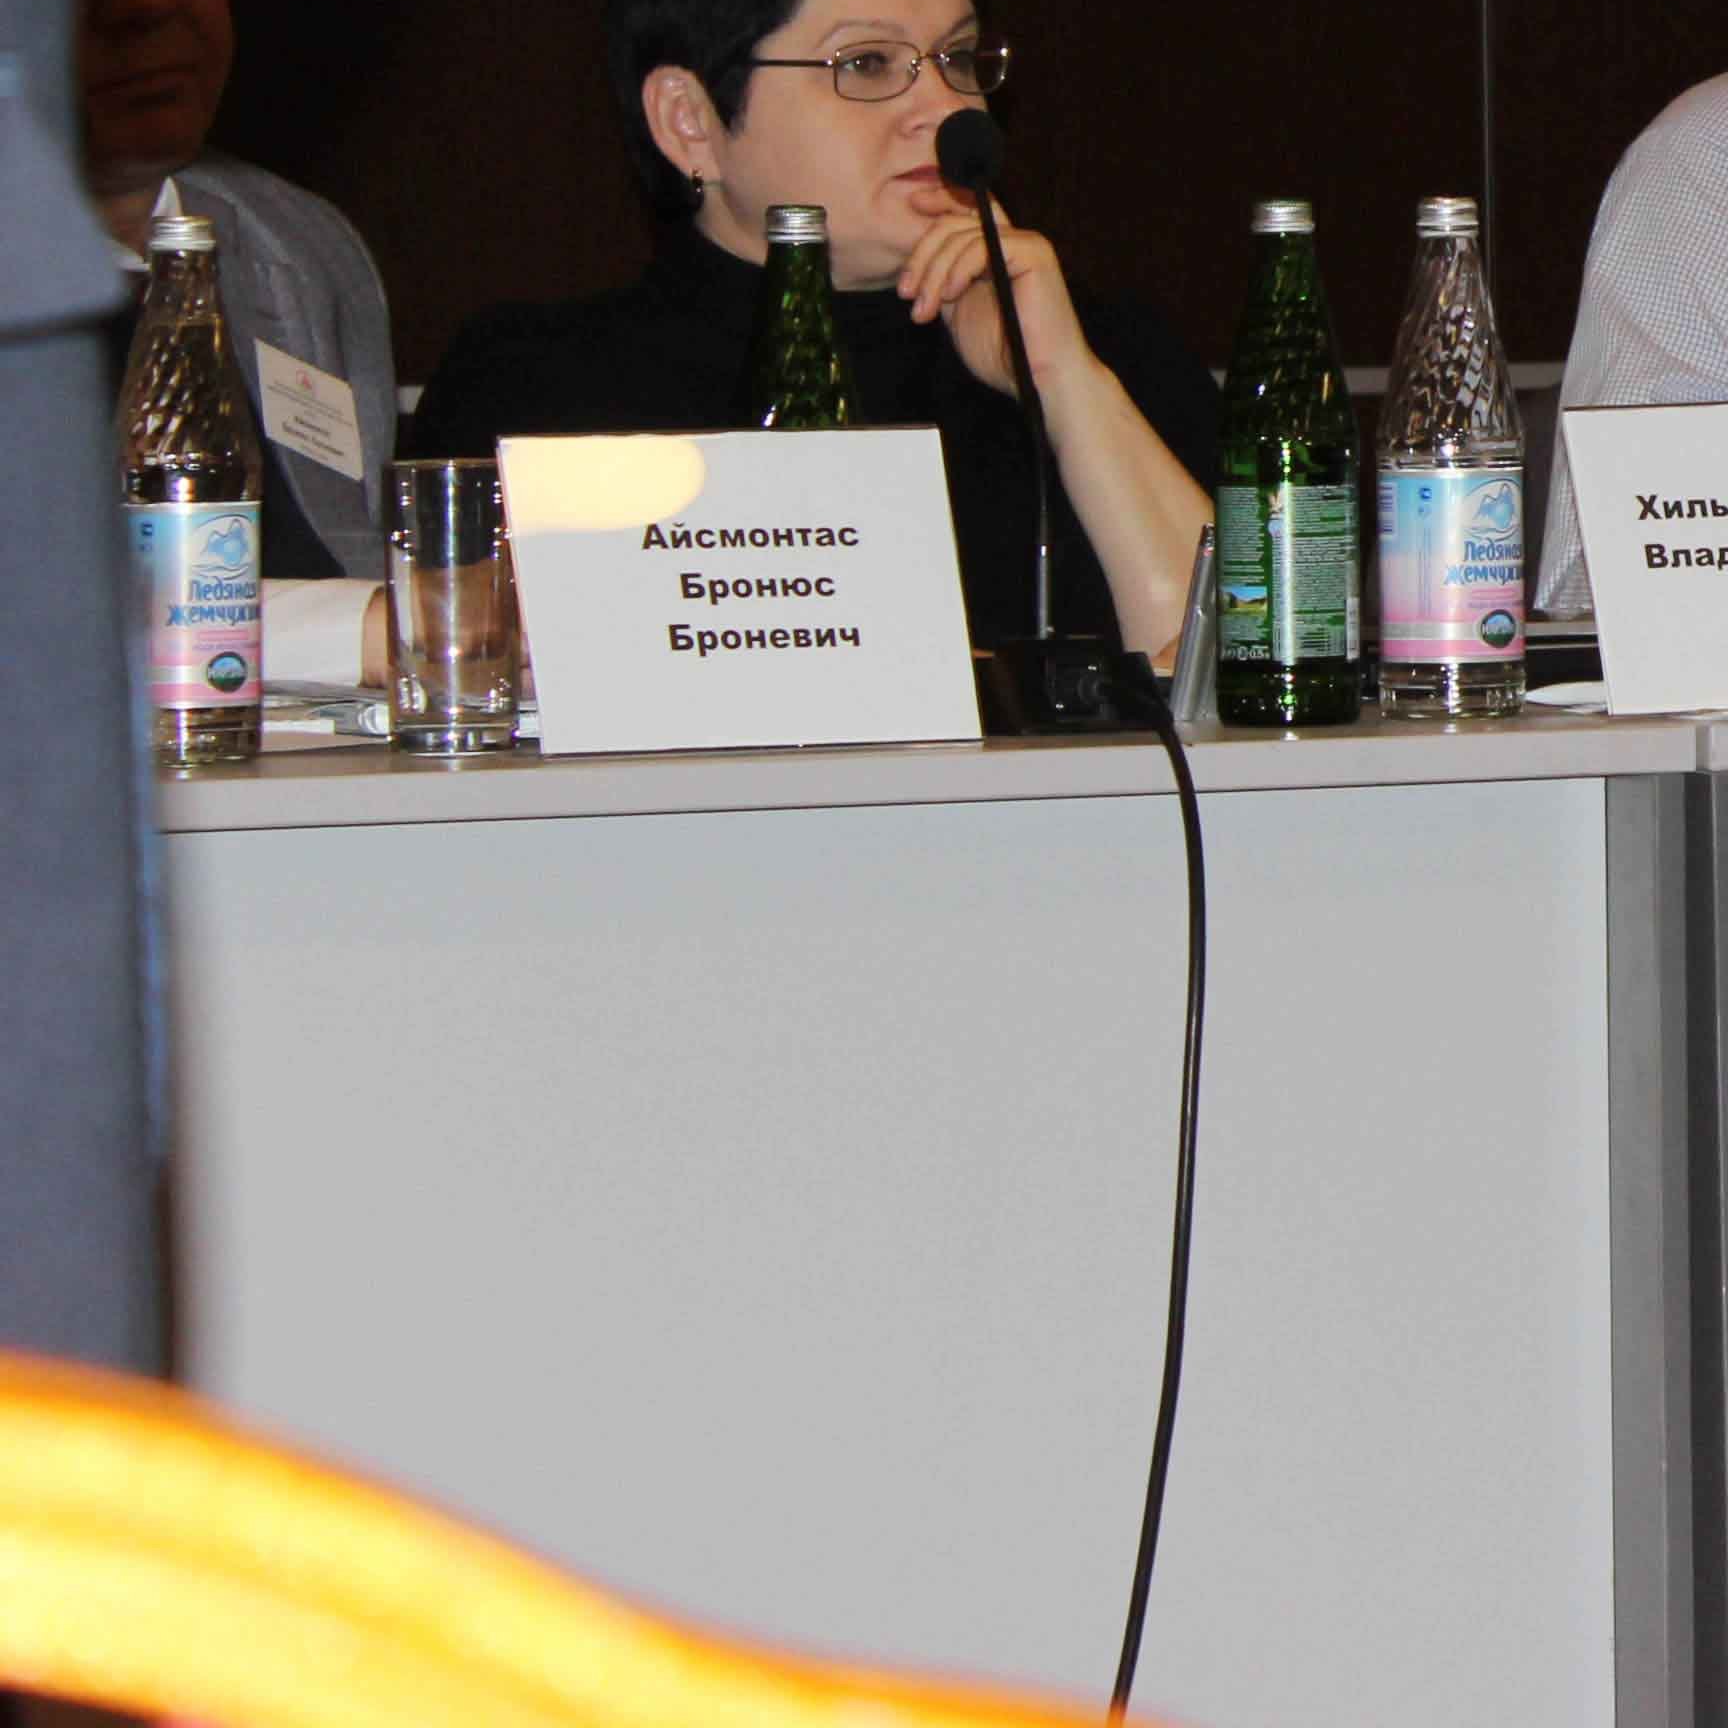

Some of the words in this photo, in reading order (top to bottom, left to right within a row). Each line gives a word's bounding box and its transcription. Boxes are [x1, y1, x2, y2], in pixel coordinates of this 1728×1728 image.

[641, 522, 860, 550] Айсмонтас
[679, 572, 836, 606] Бронюс
[668, 623, 861, 657] Броневич
